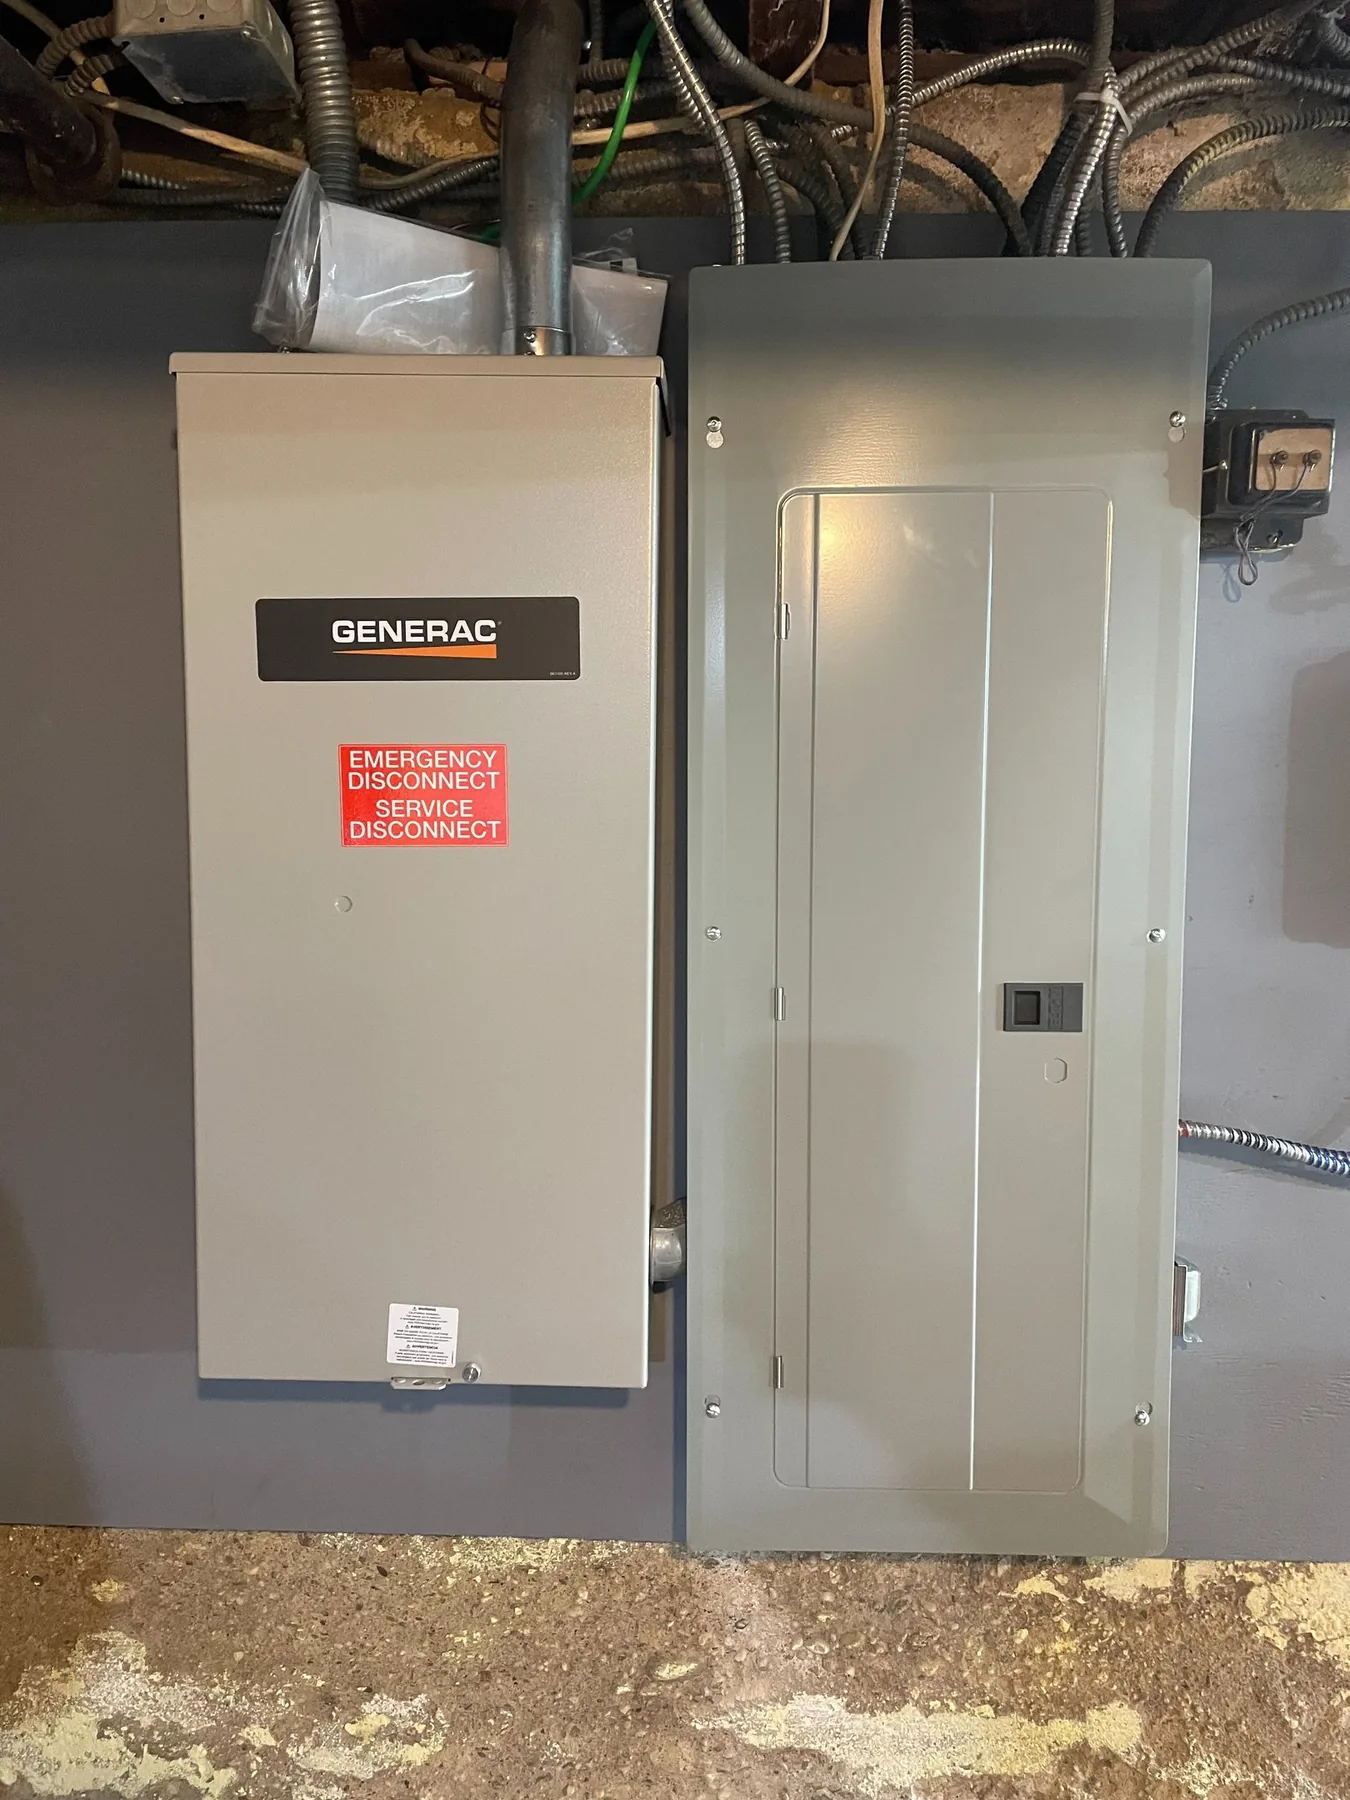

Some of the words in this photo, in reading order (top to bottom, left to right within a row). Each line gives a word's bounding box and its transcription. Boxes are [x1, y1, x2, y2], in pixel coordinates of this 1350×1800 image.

[331, 619, 497, 643] GENERAC
[350, 750, 497, 768] EMERGENCY
[348, 771, 500, 790] DISCONNECT
[376, 799, 473, 818] SERVICE
[350, 820, 501, 839] DISCONNECT
